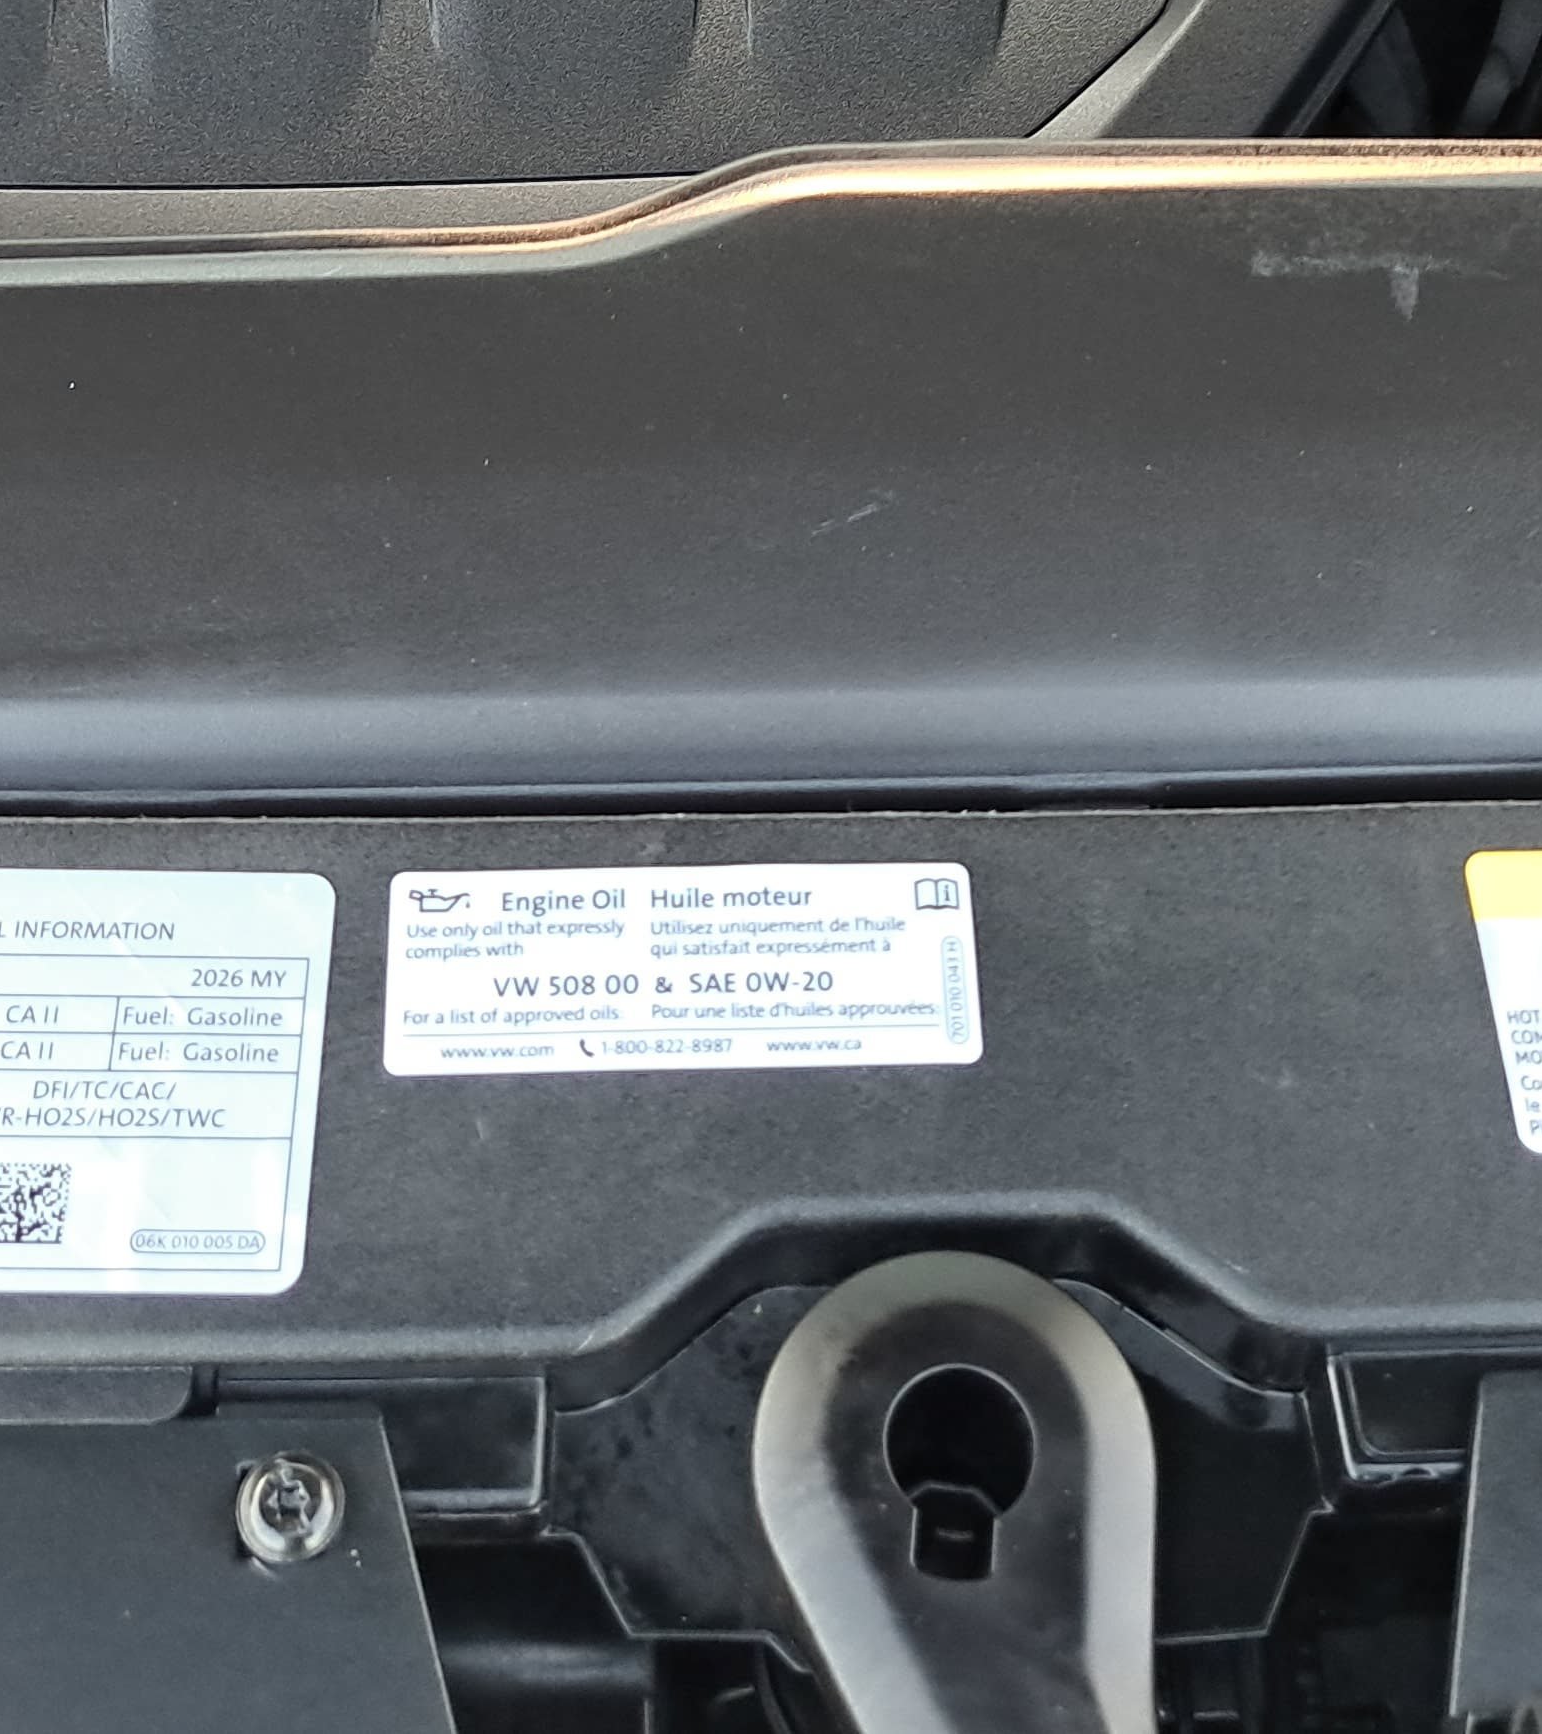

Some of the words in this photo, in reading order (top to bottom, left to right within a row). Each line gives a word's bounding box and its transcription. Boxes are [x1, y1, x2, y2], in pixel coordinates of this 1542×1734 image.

[502, 890, 585, 917] Engine
[592, 888, 625, 910] Oil
[651, 887, 715, 909] Huile
[723, 887, 812, 907] moteur
[14, 920, 175, 941] INFORMATION
[406, 924, 438, 939] Use
[442, 923, 479, 941] only
[482, 921, 503, 936] oil
[507, 921, 542, 936] that
[546, 919, 625, 938] expressly
[650, 921, 713, 936] Utilisez
[719, 920, 824, 937] uniquement
[854, 917, 906, 932] l'huile
[405, 943, 481, 962] complies
[486, 942, 524, 957] with
[650, 944, 678, 960] qui
[682, 939, 750, 956] satisfait
[755, 939, 876, 957] expressément
[190, 968, 244, 988] 2026
[251, 969, 287, 988] MY
[493, 976, 540, 997] VW
[549, 974, 596, 997] 508
[605, 973, 639, 995] 00
[655, 976, 673, 994] &
[689, 972, 736, 994] SAE
[746, 970, 834, 993] 0W-20
[6, 1004, 36, 1024] CA
[187, 1007, 283, 1027] Gasoline
[403, 1010, 430, 1025] For
[435, 1013, 445, 1025] a
[450, 1009, 475, 1024] list
[480, 1008, 498, 1024] of
[503, 1007, 585, 1027] approved
[651, 1003, 690, 1019] Pour
[694, 1007, 727, 1019] une
[731, 1003, 766, 1019] liste
[769, 1001, 834, 1018] d'huiles
[1506, 1009, 1540, 1025] HOT
[0, 1040, 31, 1060] CA
[183, 1042, 279, 1063] Gasoline
[440, 1045, 555, 1059] www.vw.com
[766, 1040, 862, 1052] www.vw.ca
[33, 1080, 177, 1101] DFI/TC/CAC/
